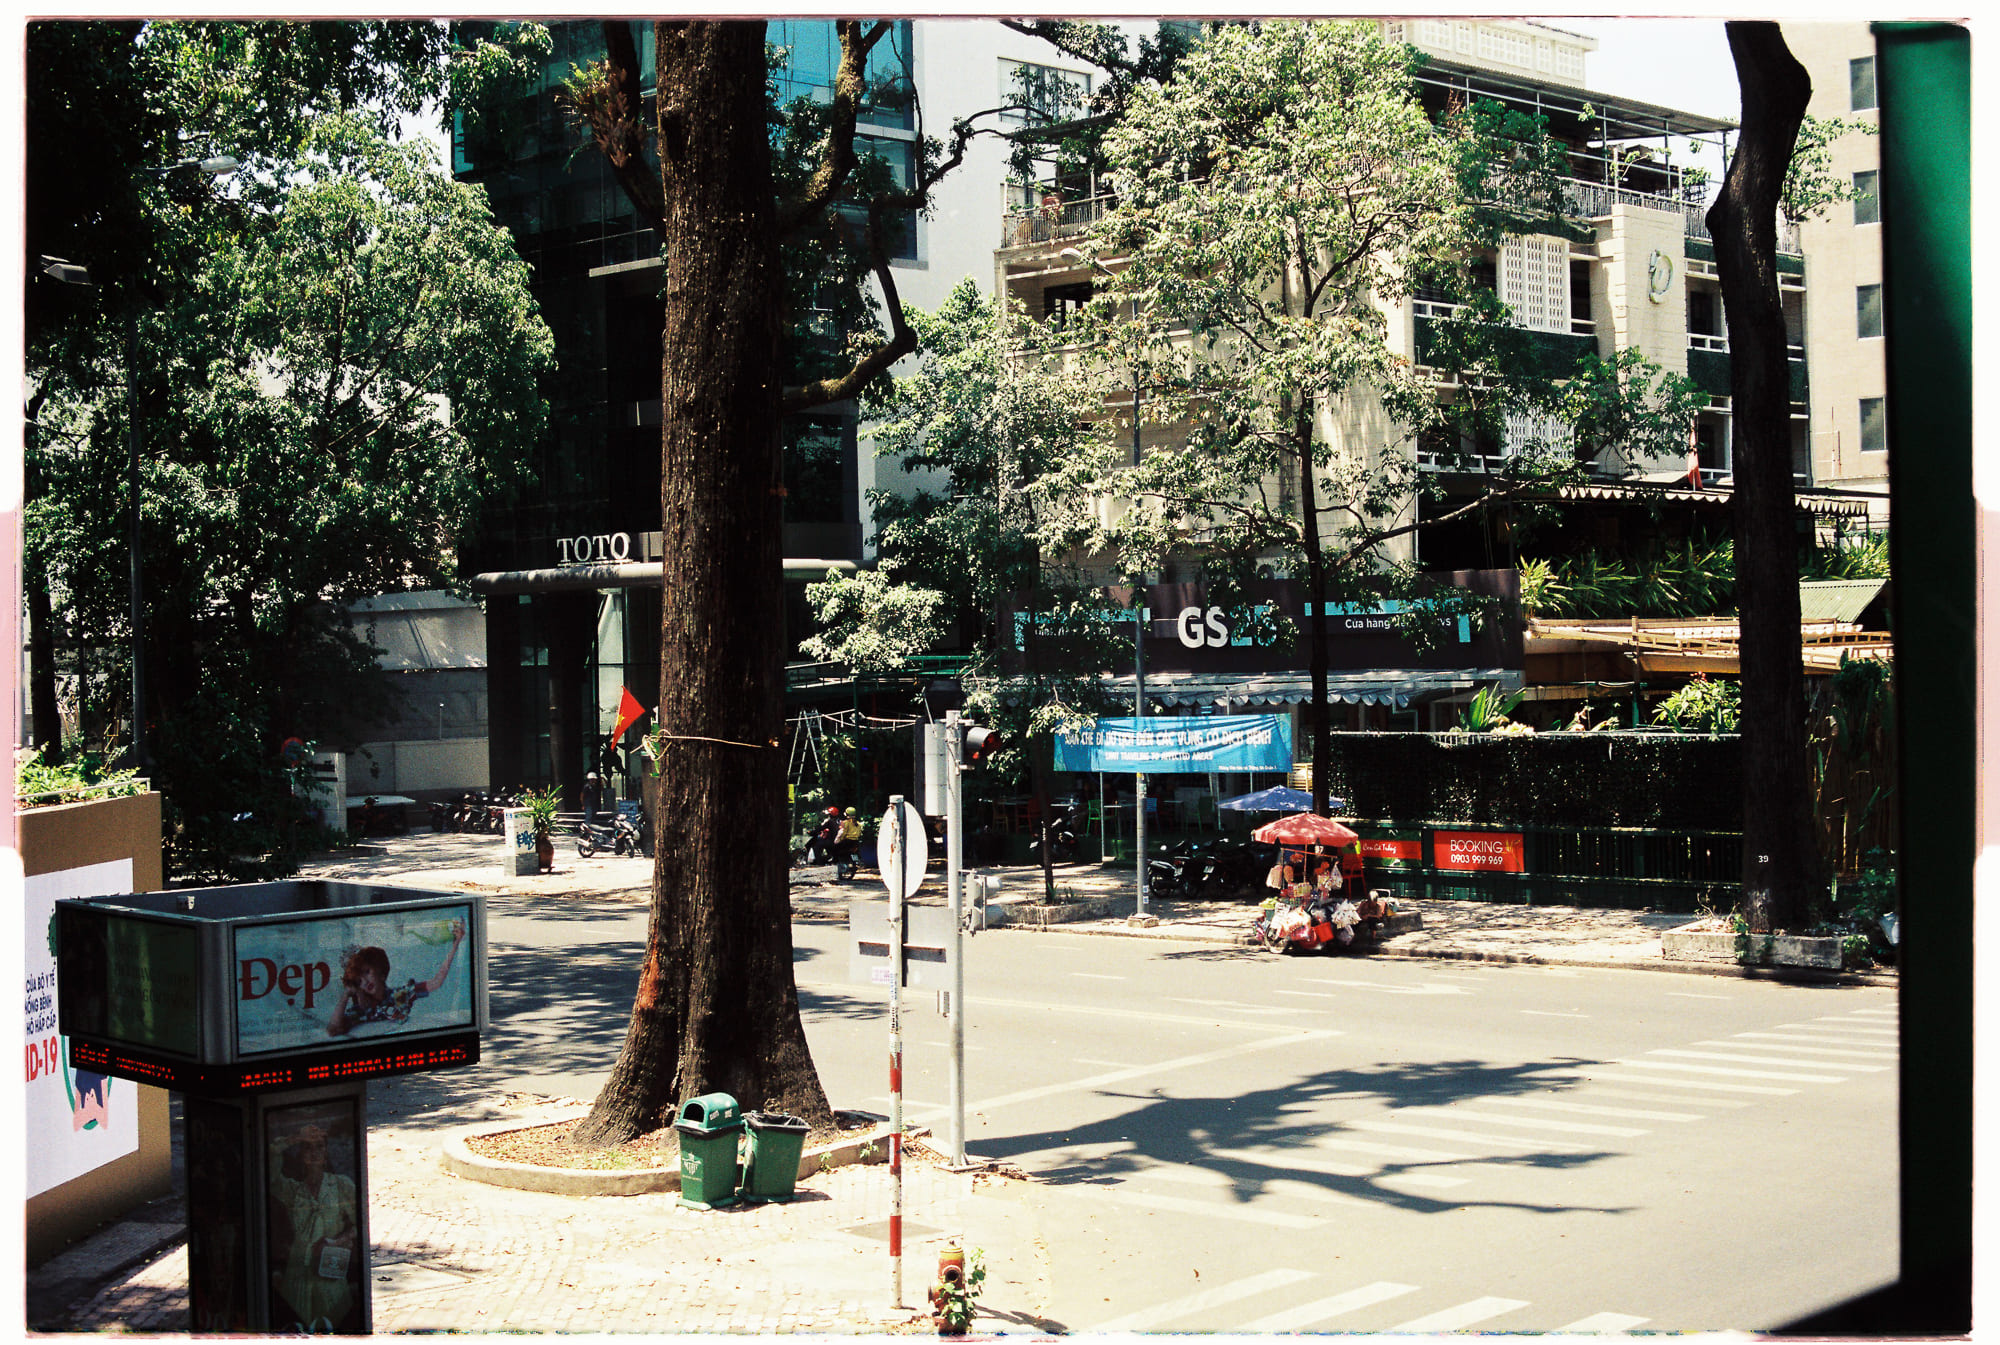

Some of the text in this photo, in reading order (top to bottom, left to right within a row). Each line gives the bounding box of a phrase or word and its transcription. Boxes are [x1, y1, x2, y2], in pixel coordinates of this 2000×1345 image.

[556, 532, 631, 562] TOTO
[1450, 839, 1503, 855] BOOKING
[1451, 854, 1503, 866] 0903 999 969
[1758, 855, 1769, 863] 39
[238, 957, 331, 1009] Đẹp
